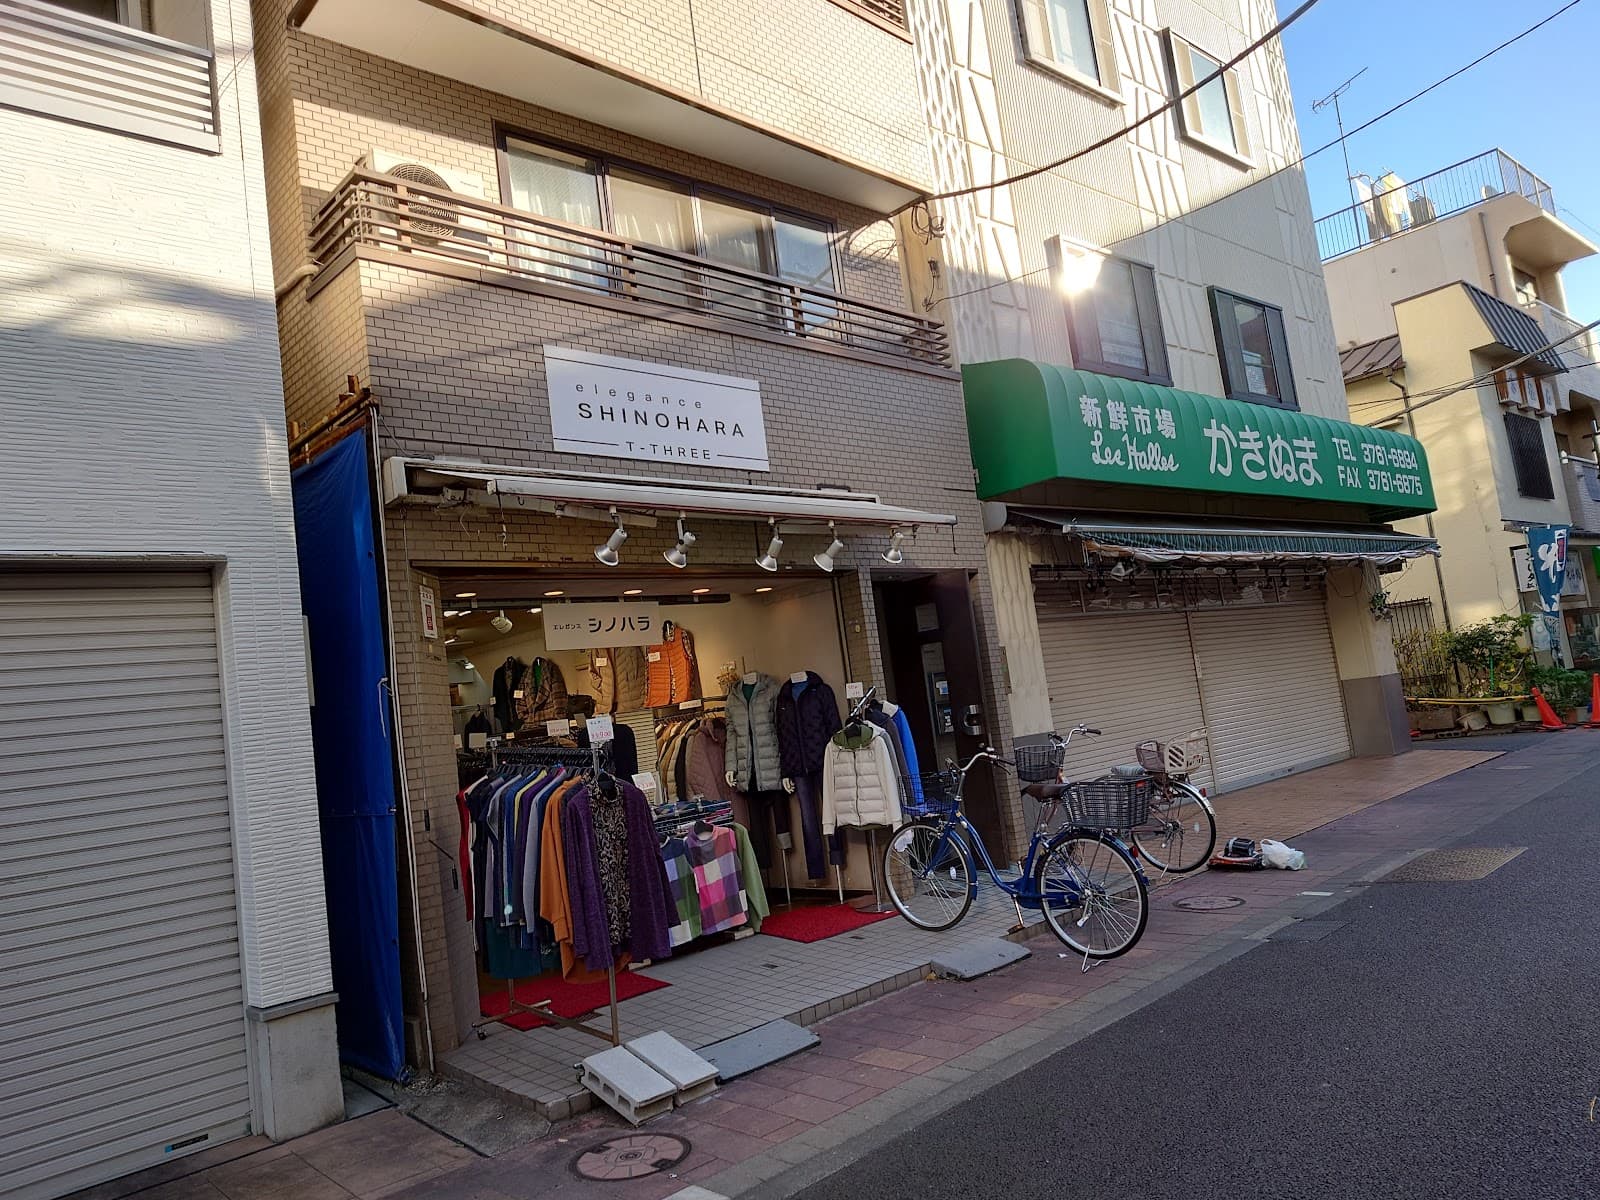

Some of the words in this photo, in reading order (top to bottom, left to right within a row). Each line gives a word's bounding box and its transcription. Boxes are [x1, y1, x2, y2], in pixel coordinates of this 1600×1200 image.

[575, 383, 702, 409] elegance
[578, 402, 745, 438] SHINOHARA
[1079, 394, 1177, 440] 新鮮市場
[625, 441, 712, 460] T-THREE
[1090, 430, 1126, 466] Les
[1122, 432, 1180, 472] Halles
[1203, 418, 1324, 487] かきぬま
[1331, 437, 1357, 462] TEL
[1337, 465, 1362, 489] FAX
[588, 616, 650, 633] シノハラ
